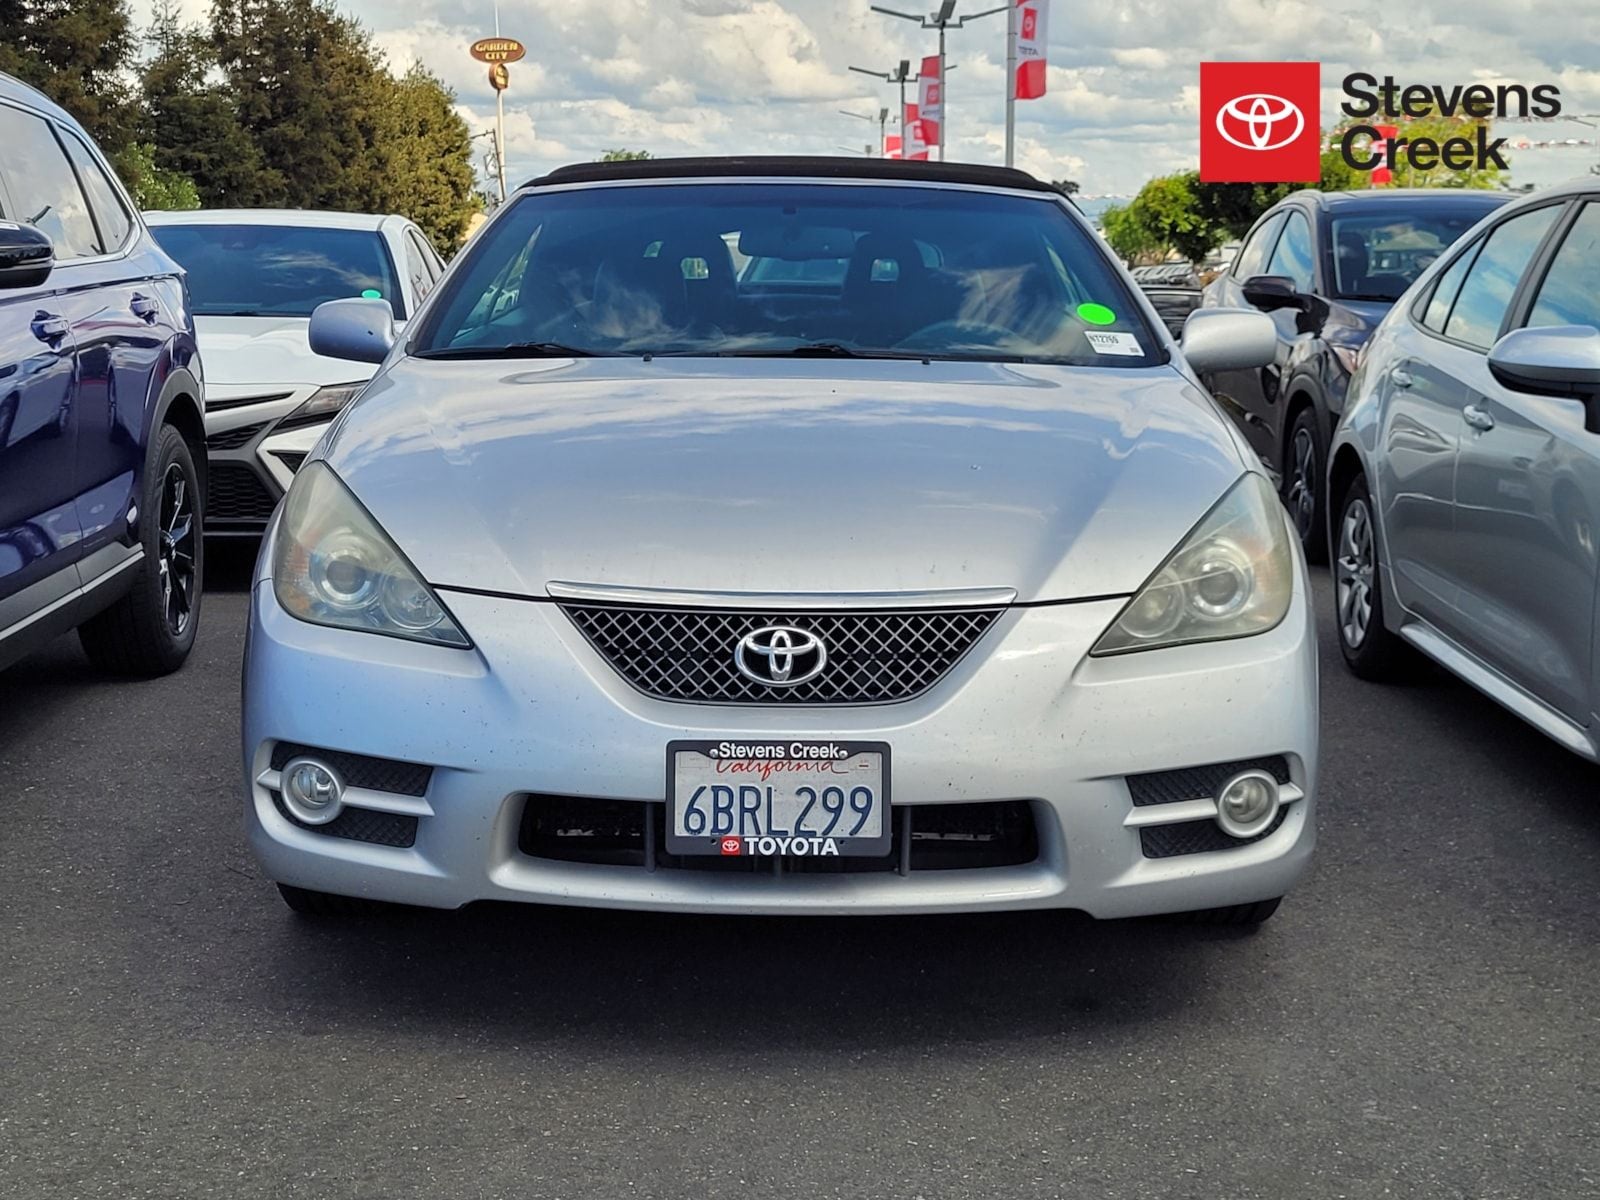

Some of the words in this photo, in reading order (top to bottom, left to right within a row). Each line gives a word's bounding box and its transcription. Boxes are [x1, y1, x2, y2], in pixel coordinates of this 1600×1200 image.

[475, 42, 518, 52] GARDEN
[485, 52, 508, 60] CITY
[719, 742, 785, 759] Stevens
[790, 743, 840, 759] Creek
[716, 758, 849, 782] California
[684, 785, 873, 837] 6BRL299
[744, 838, 839, 856] TOYOTA
